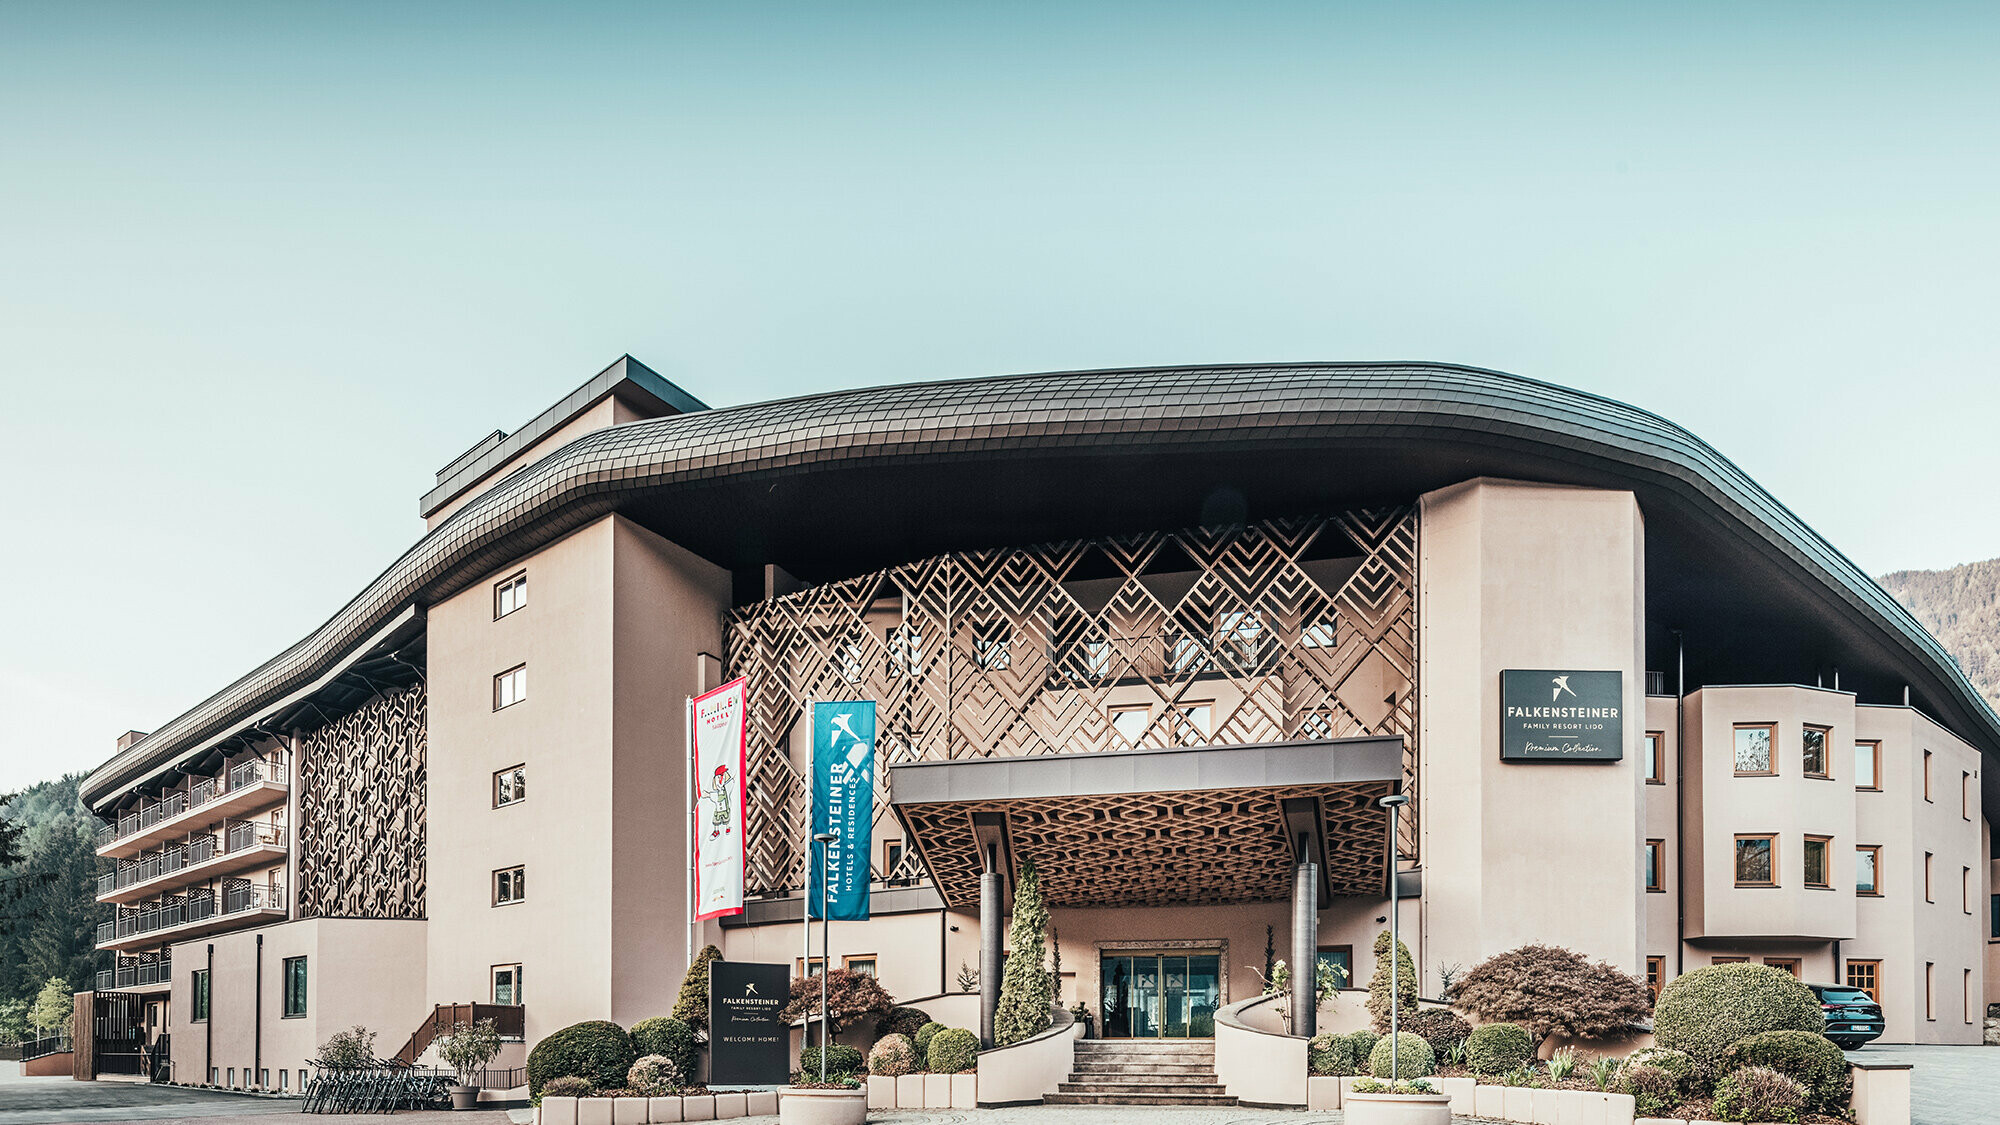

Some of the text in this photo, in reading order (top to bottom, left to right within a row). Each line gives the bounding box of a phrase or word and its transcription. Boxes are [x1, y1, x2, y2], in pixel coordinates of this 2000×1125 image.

[1508, 706, 1618, 718] FALKENSTEINER
[1524, 741, 1602, 755] Premium Collection
[847, 777, 857, 839] RESIDENCES
[827, 763, 844, 903] FALKENSTEINER
[845, 853, 854, 892] HOTELS
